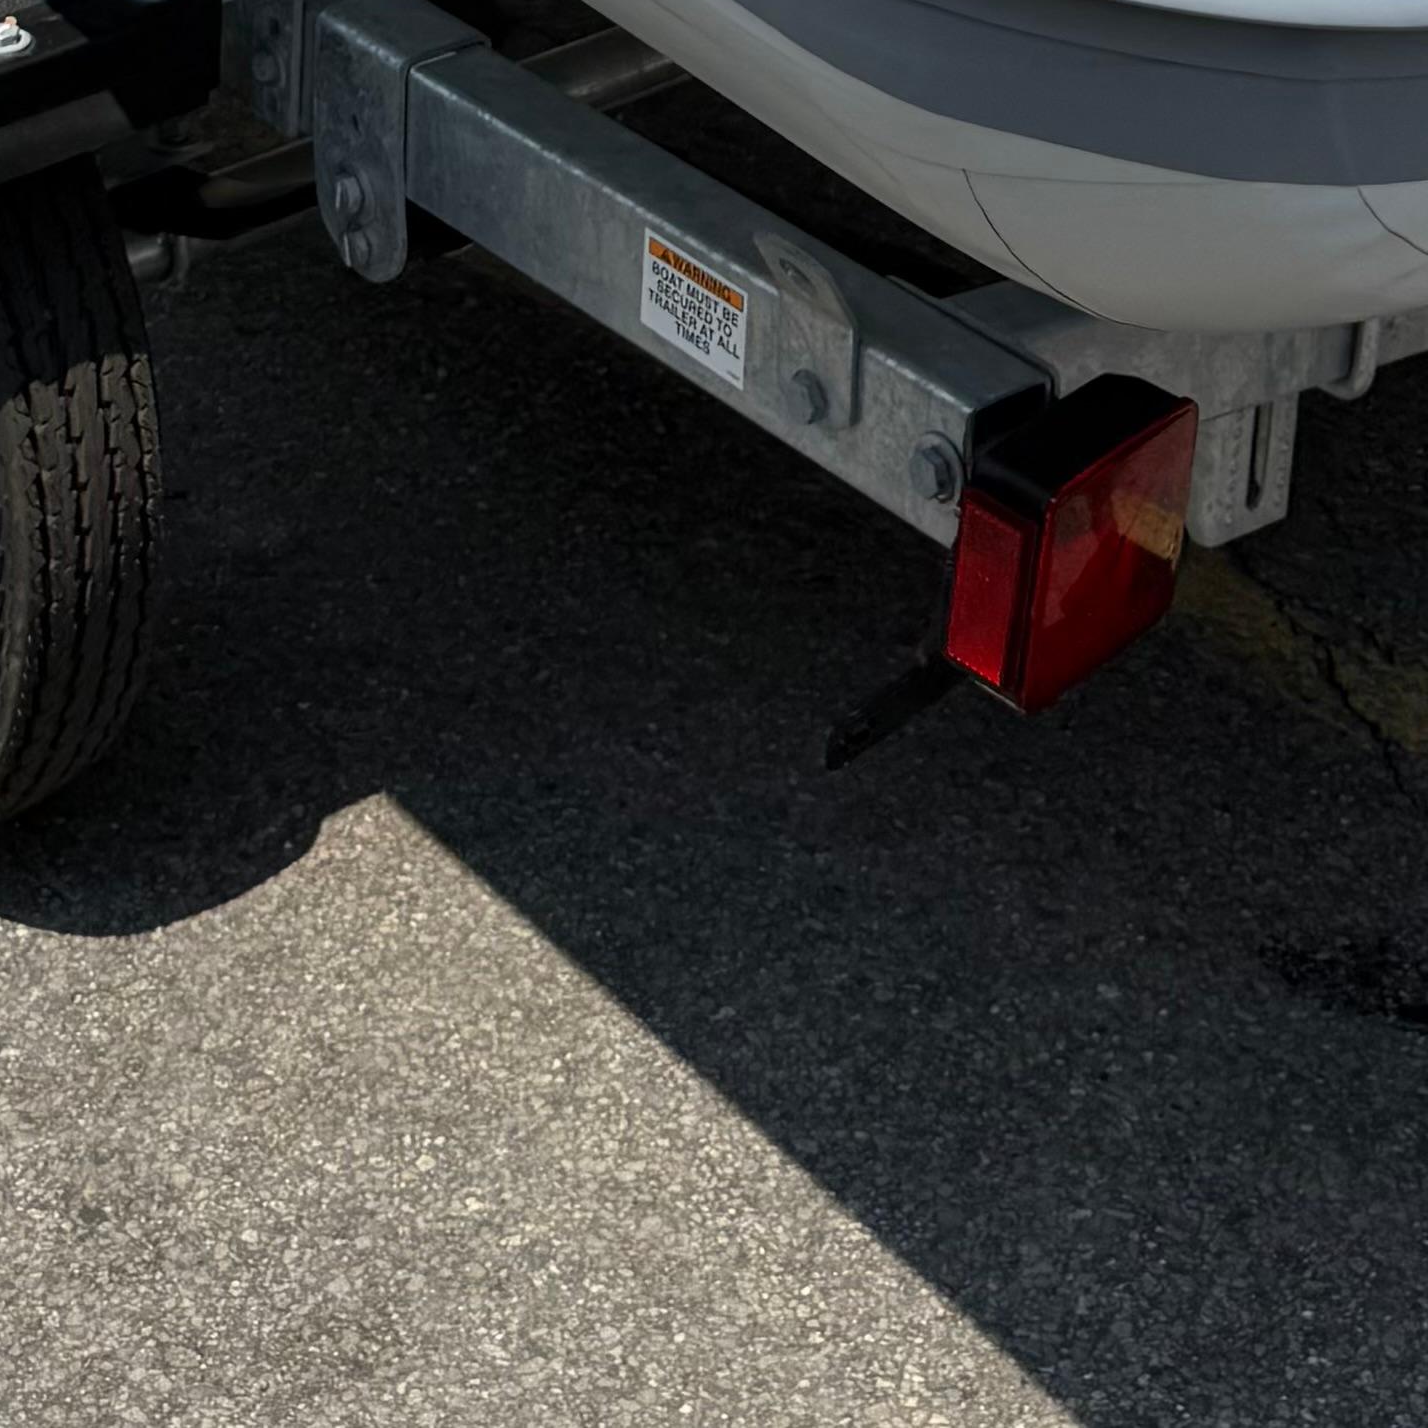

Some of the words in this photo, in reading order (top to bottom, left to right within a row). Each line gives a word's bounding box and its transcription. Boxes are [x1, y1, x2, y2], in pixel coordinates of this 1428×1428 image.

[652, 261, 684, 289] BOAT
[686, 282, 722, 314] MUST
[722, 307, 740, 329] BE
[656, 279, 714, 326] SECURED
[716, 318, 733, 338] TO
[673, 255, 732, 303] WARNING
[648, 287, 698, 332] TRAILER
[699, 325, 716, 343] AT
[716, 335, 741, 361] ALL
[675, 320, 711, 356] TIMES
